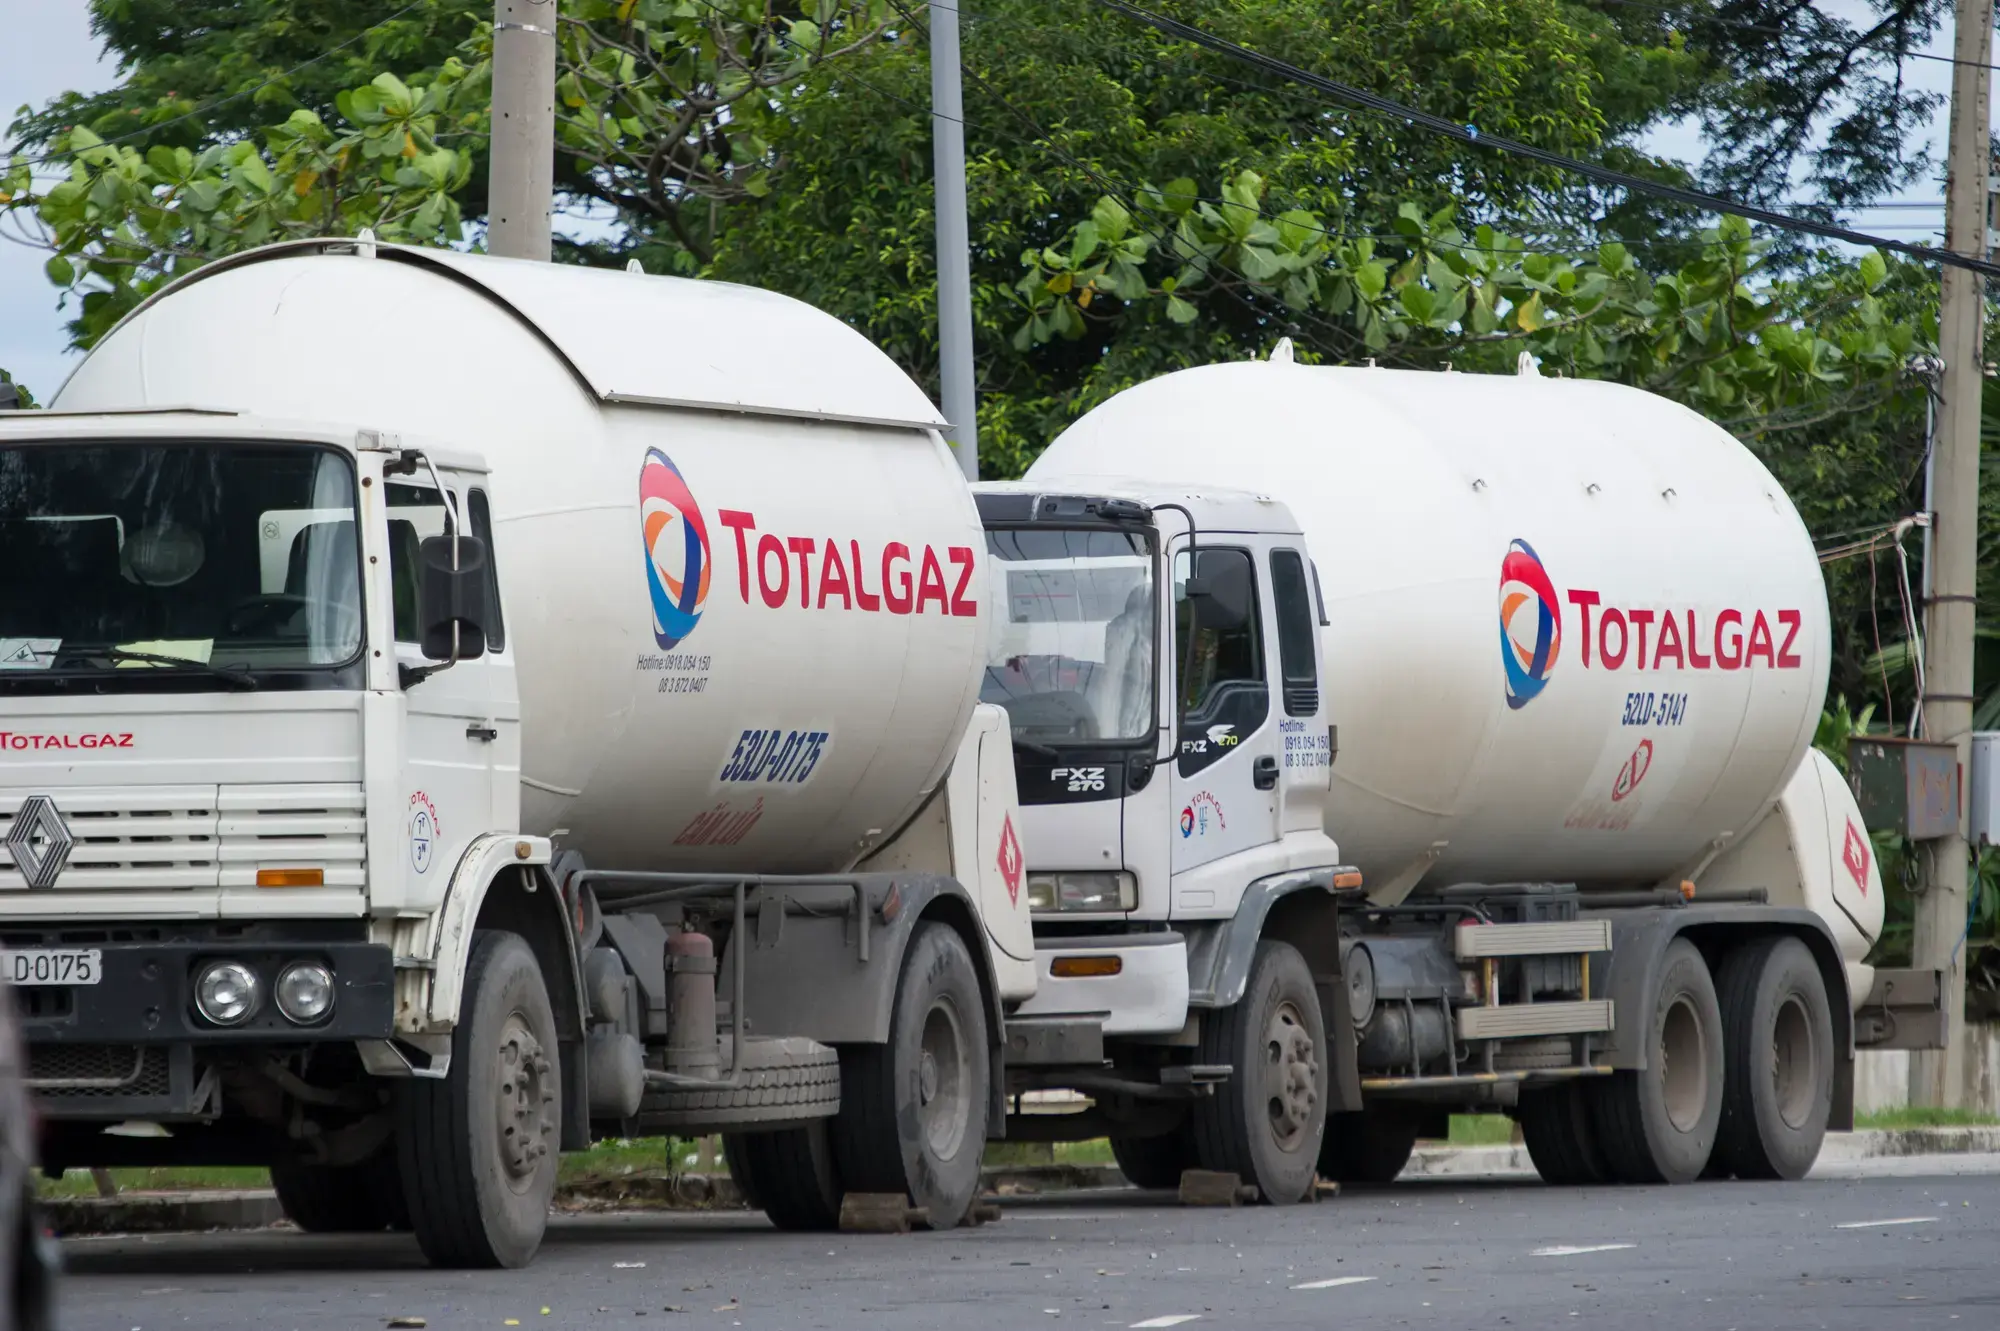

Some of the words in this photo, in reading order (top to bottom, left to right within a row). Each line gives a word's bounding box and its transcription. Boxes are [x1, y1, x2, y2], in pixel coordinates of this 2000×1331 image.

[718, 509, 977, 617] TOTALGAZ
[1567, 589, 1801, 670] TOTALGAZ
[1622, 692, 1688, 726] 52LD-5141
[0, 732, 134, 750] TOTALGAZ
[1182, 740, 1207, 753] FXZ
[1218, 735, 1238, 746] 270
[1051, 767, 1105, 781] FXZ
[1067, 780, 1105, 792] 270
